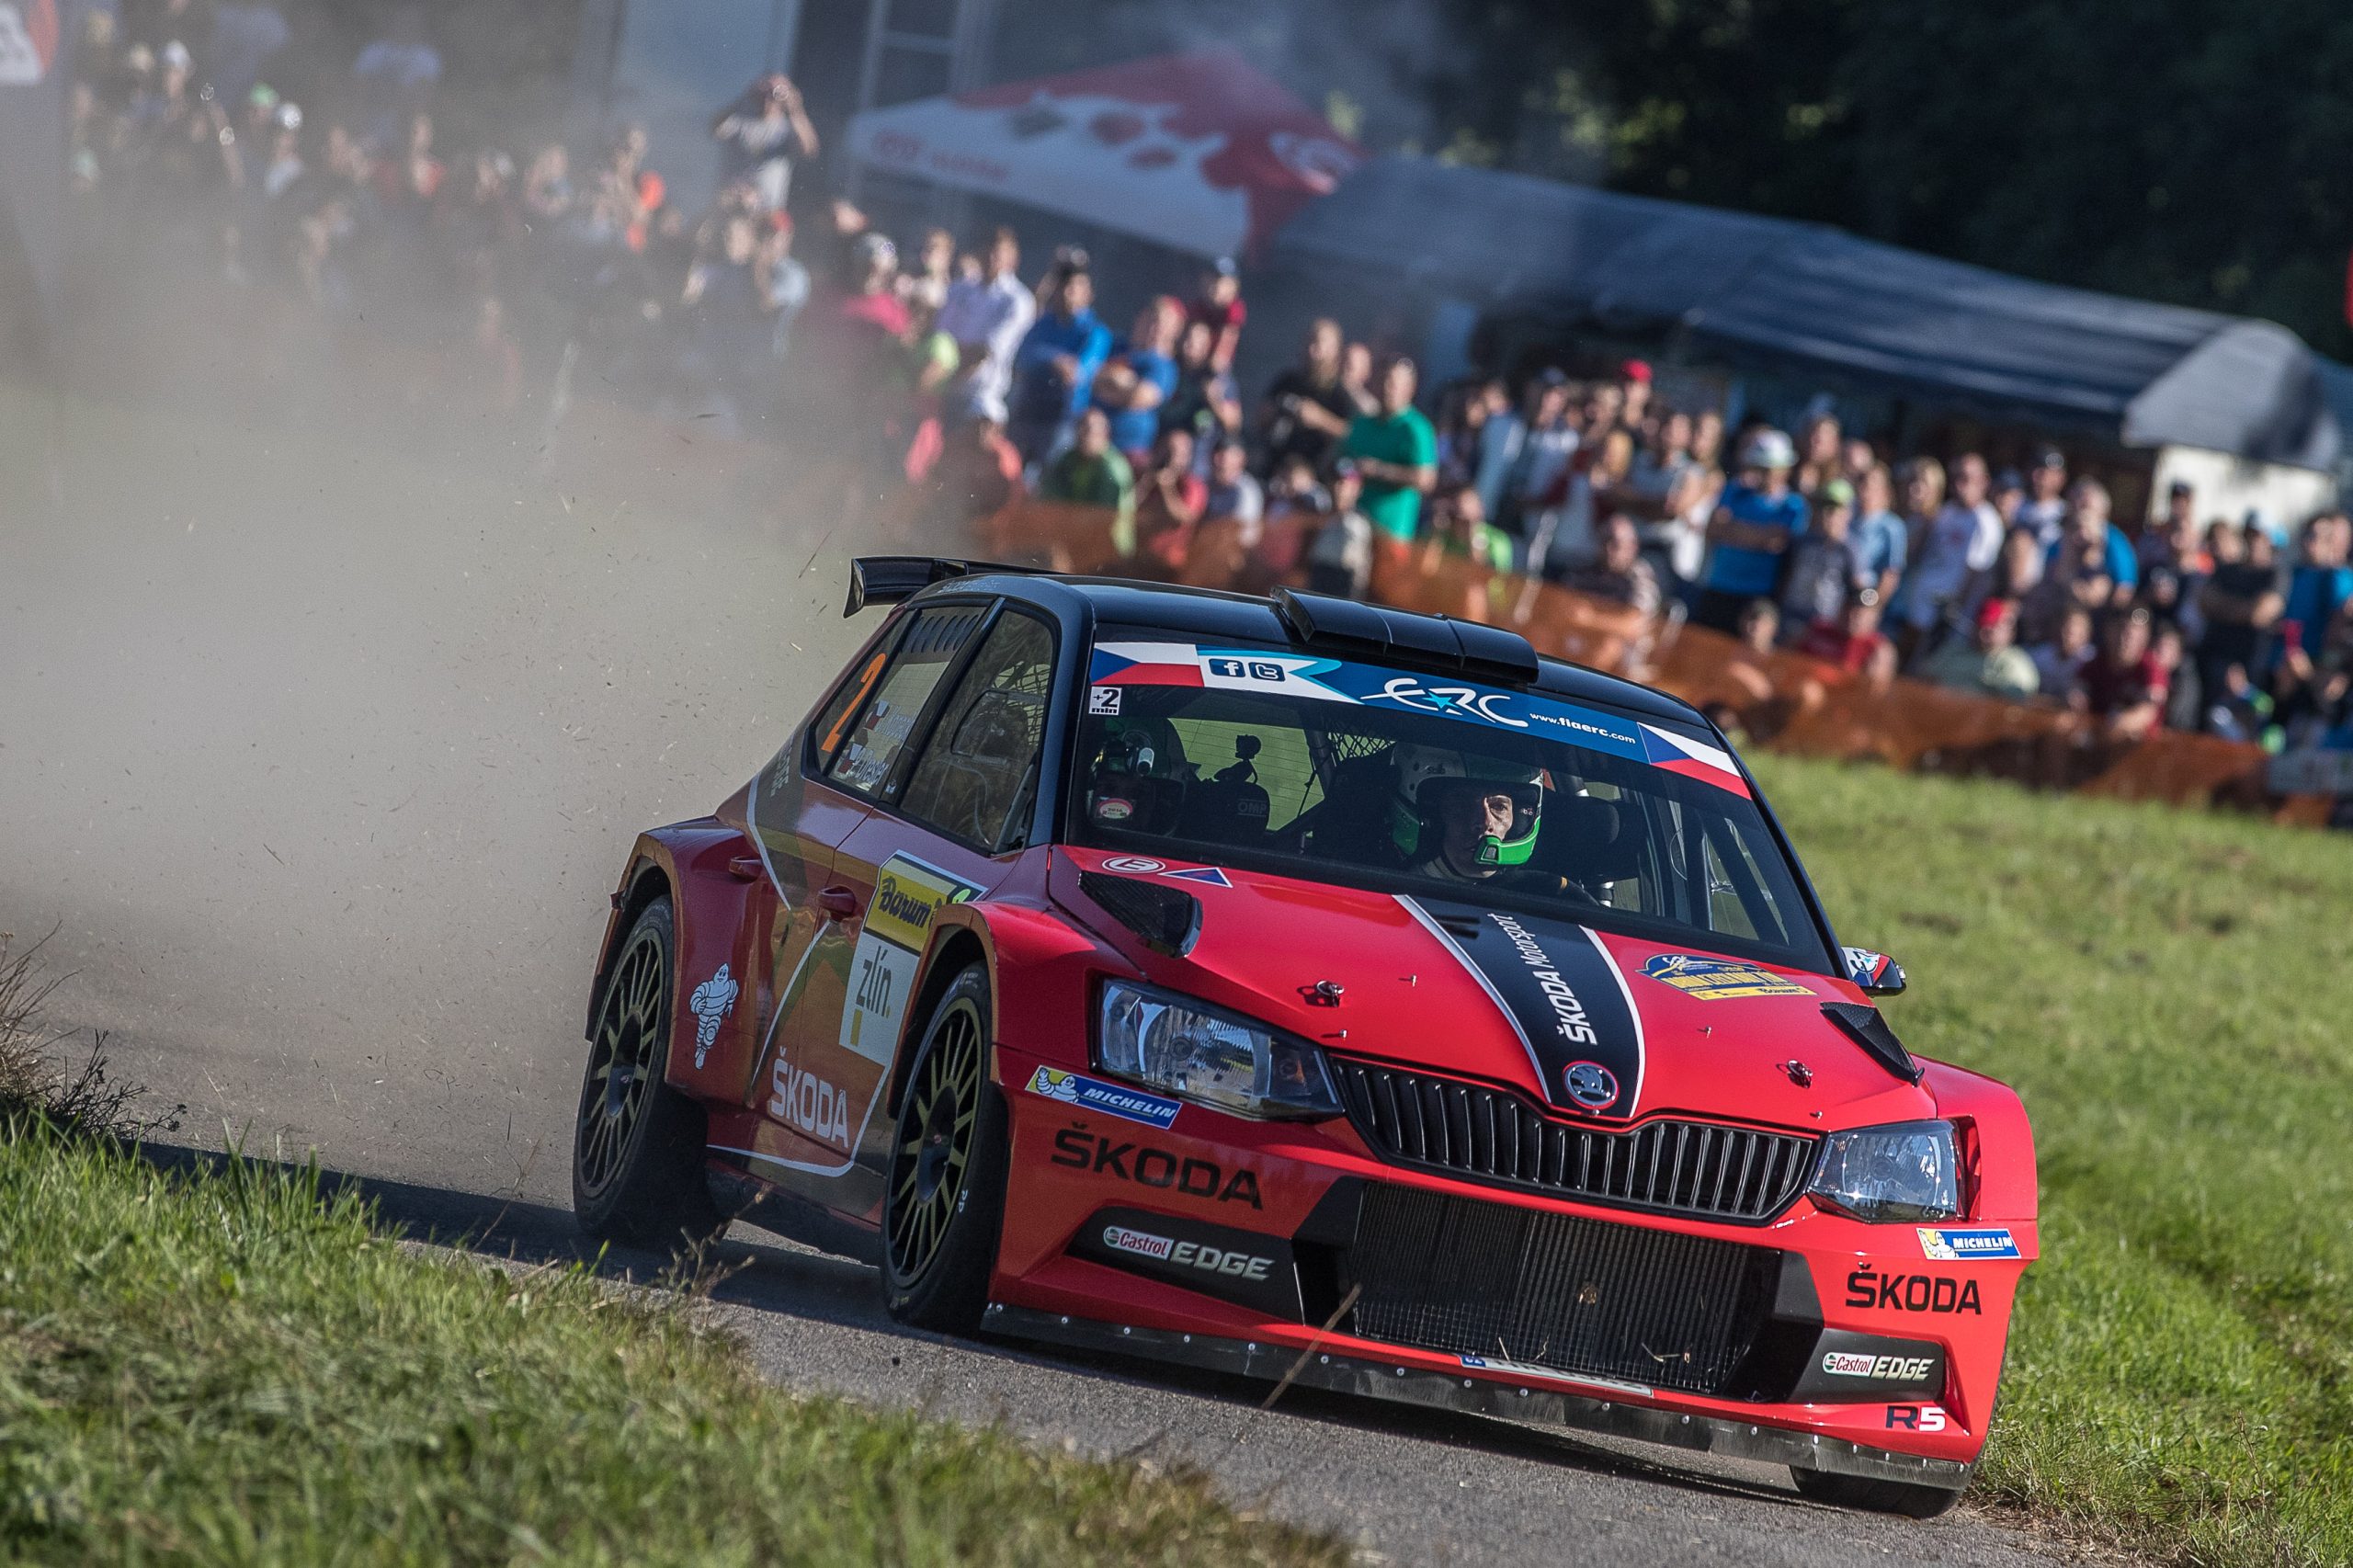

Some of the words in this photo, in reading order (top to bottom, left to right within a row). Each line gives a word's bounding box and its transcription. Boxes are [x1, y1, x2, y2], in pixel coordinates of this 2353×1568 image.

[821, 653, 886, 753] 2
[1093, 688, 1120, 708] +2
[1360, 677, 1529, 727] ERC
[1529, 712, 1636, 744] www.fiaerc.com
[879, 876, 932, 929] Barum
[1487, 913, 1555, 970] Motorsport
[1532, 971, 1598, 1046] ŠKODA
[771, 1045, 848, 1149] ŠKODA
[1084, 1087, 1176, 1118] MICHELIN
[1051, 1121, 1264, 1211] ŠKODA
[1120, 1232, 1170, 1256] Castrol
[1170, 1241, 1276, 1282] EDGE
[1952, 1236, 2013, 1249] MICHELIN
[1846, 1263, 1982, 1315] ŠKODA
[1836, 1356, 1872, 1373] Castrol
[1871, 1356, 1936, 1381] EDGE
[1885, 1404, 1946, 1432] R5
